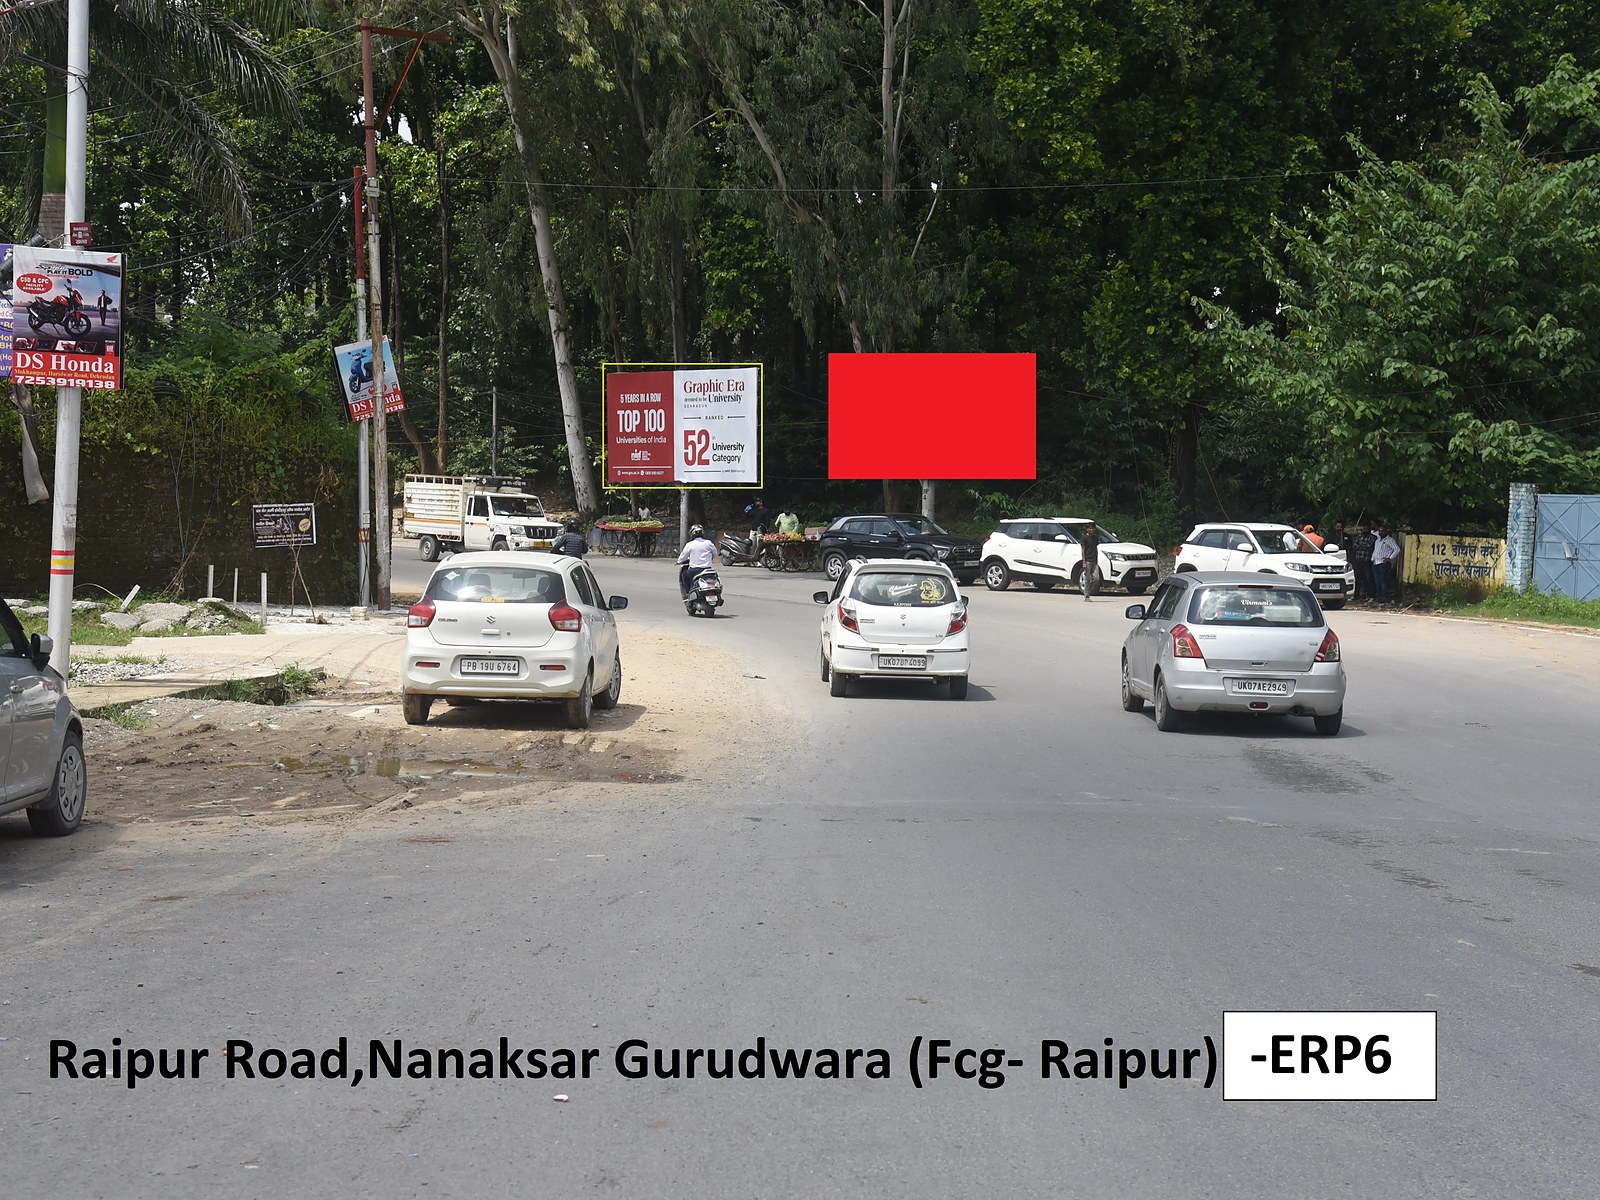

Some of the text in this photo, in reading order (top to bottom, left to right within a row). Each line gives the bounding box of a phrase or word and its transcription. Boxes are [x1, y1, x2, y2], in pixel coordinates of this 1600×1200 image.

[68, 268, 93, 277] BOLD
[16, 352, 115, 374] DS Honda
[48, 370, 73, 378] Haridwar
[14, 375, 115, 389] 7253919138
[683, 379, 745, 396] Graphic Era
[620, 392, 661, 404] 5 YEARS IN A ROW
[708, 393, 743, 404] University
[352, 401, 367, 413] DS
[617, 409, 665, 433] TOP 100
[616, 436, 647, 444] Universities
[683, 428, 710, 467] 52
[712, 442, 745, 453] University
[712, 453, 742, 464] Category
[1431, 543, 1447, 556] 112
[1434, 559, 1460, 579] पुलिस
[467, 661, 477, 671] PB
[497, 662, 517, 672] 6764
[1237, 681, 1287, 692] UK07AE2949
